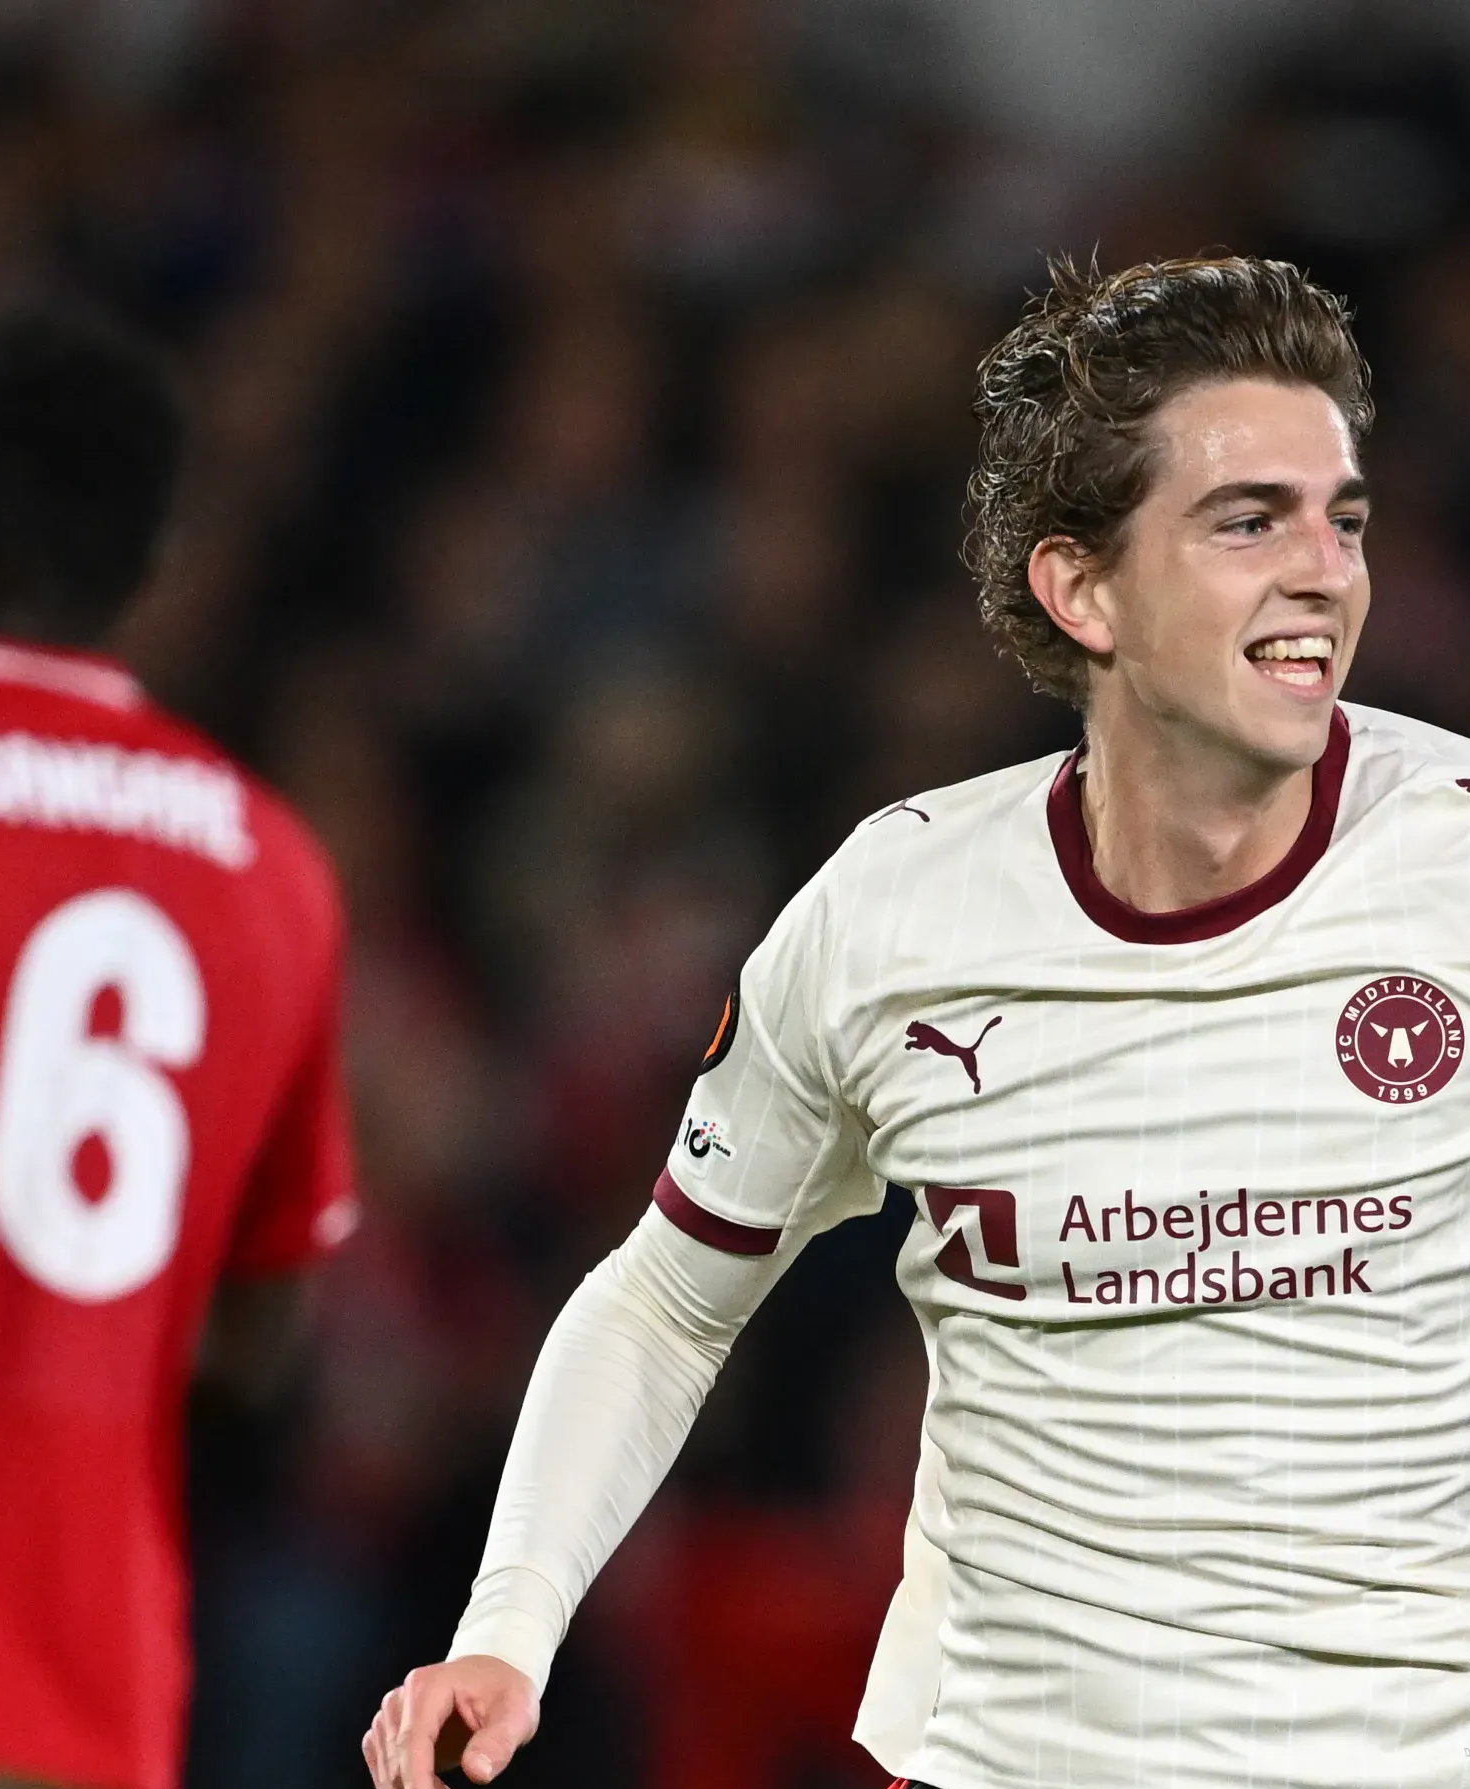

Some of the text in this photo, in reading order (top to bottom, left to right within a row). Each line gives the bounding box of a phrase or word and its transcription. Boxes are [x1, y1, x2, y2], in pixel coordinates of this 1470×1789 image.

[1338, 979, 1462, 1063] FC MIDTJYLLAND
[1377, 1083, 1429, 1101] 1999
[1058, 1187, 1413, 1253] Arbejdernes
[1061, 1247, 1374, 1305] Landsbank
